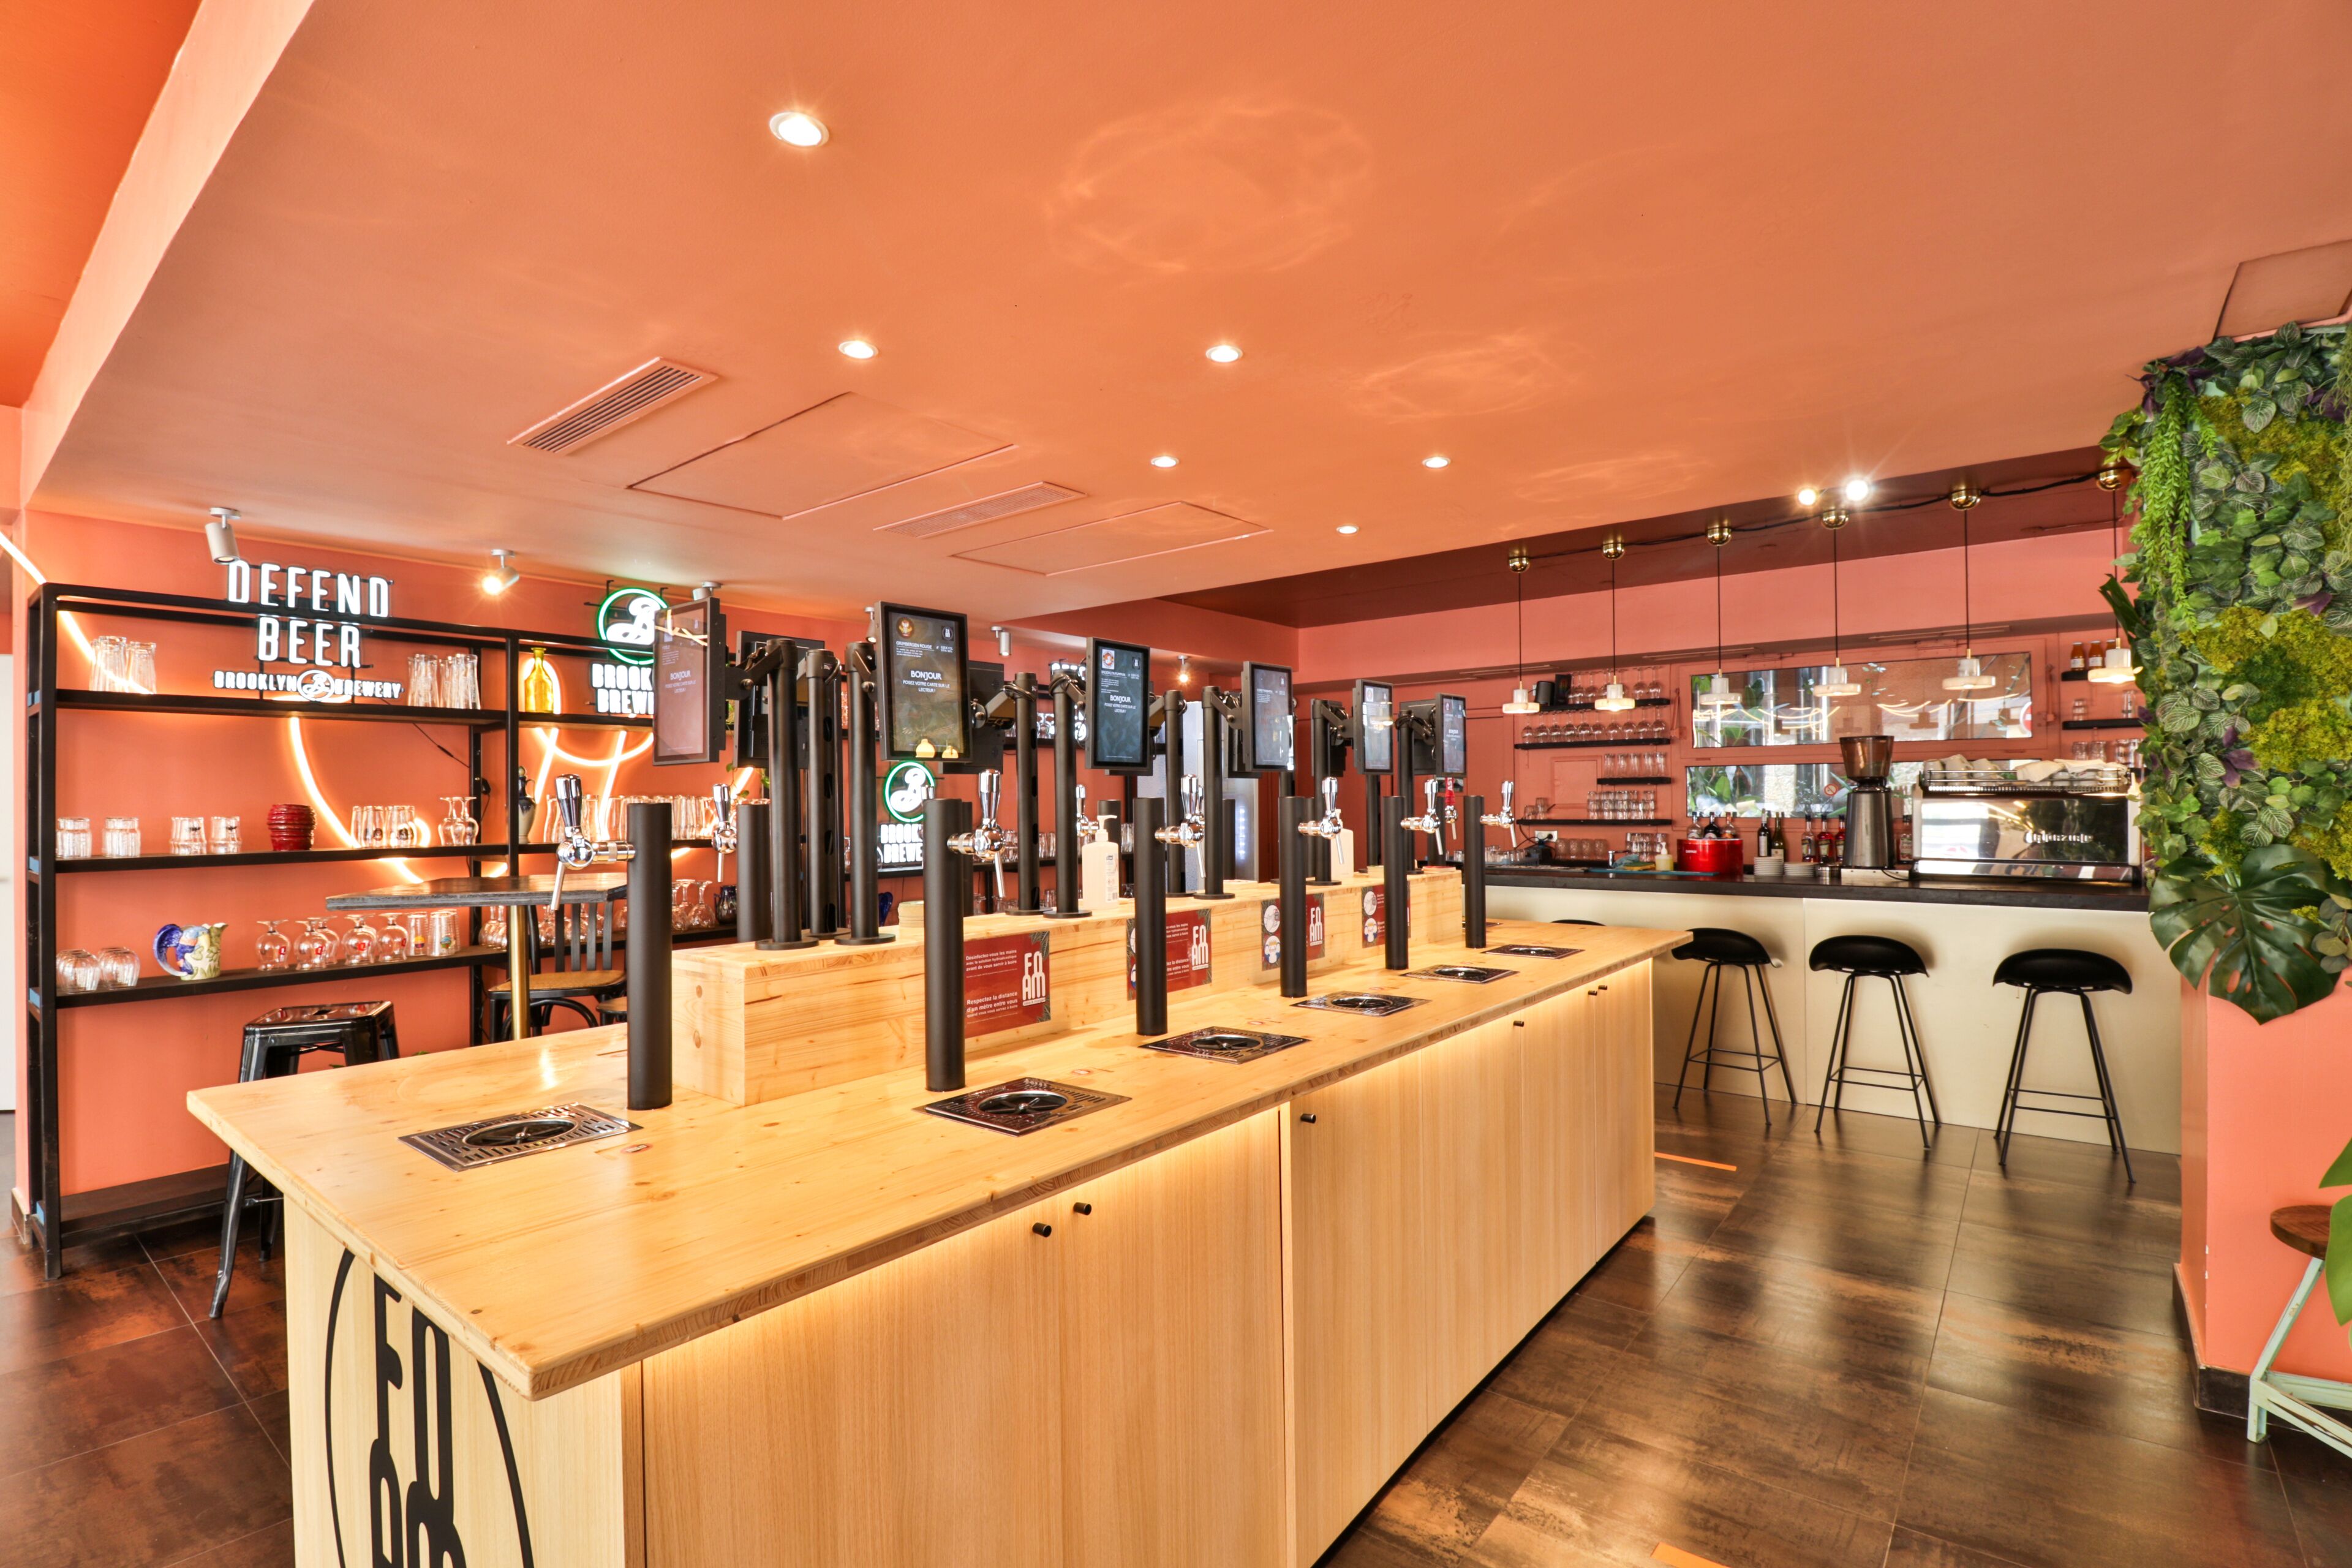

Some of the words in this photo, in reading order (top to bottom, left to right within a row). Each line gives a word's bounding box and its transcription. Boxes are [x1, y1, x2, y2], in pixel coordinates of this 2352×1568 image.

[228, 559, 390, 617] DEFEND
[257, 616, 361, 668] BEER
[214, 670, 298, 692] BROOKLYN
[334, 679, 401, 699] BREWERY
[910, 670, 942, 680] BONJOUR
[1110, 695, 1131, 704] BONJOUR
[967, 996, 992, 1005] Respectez
